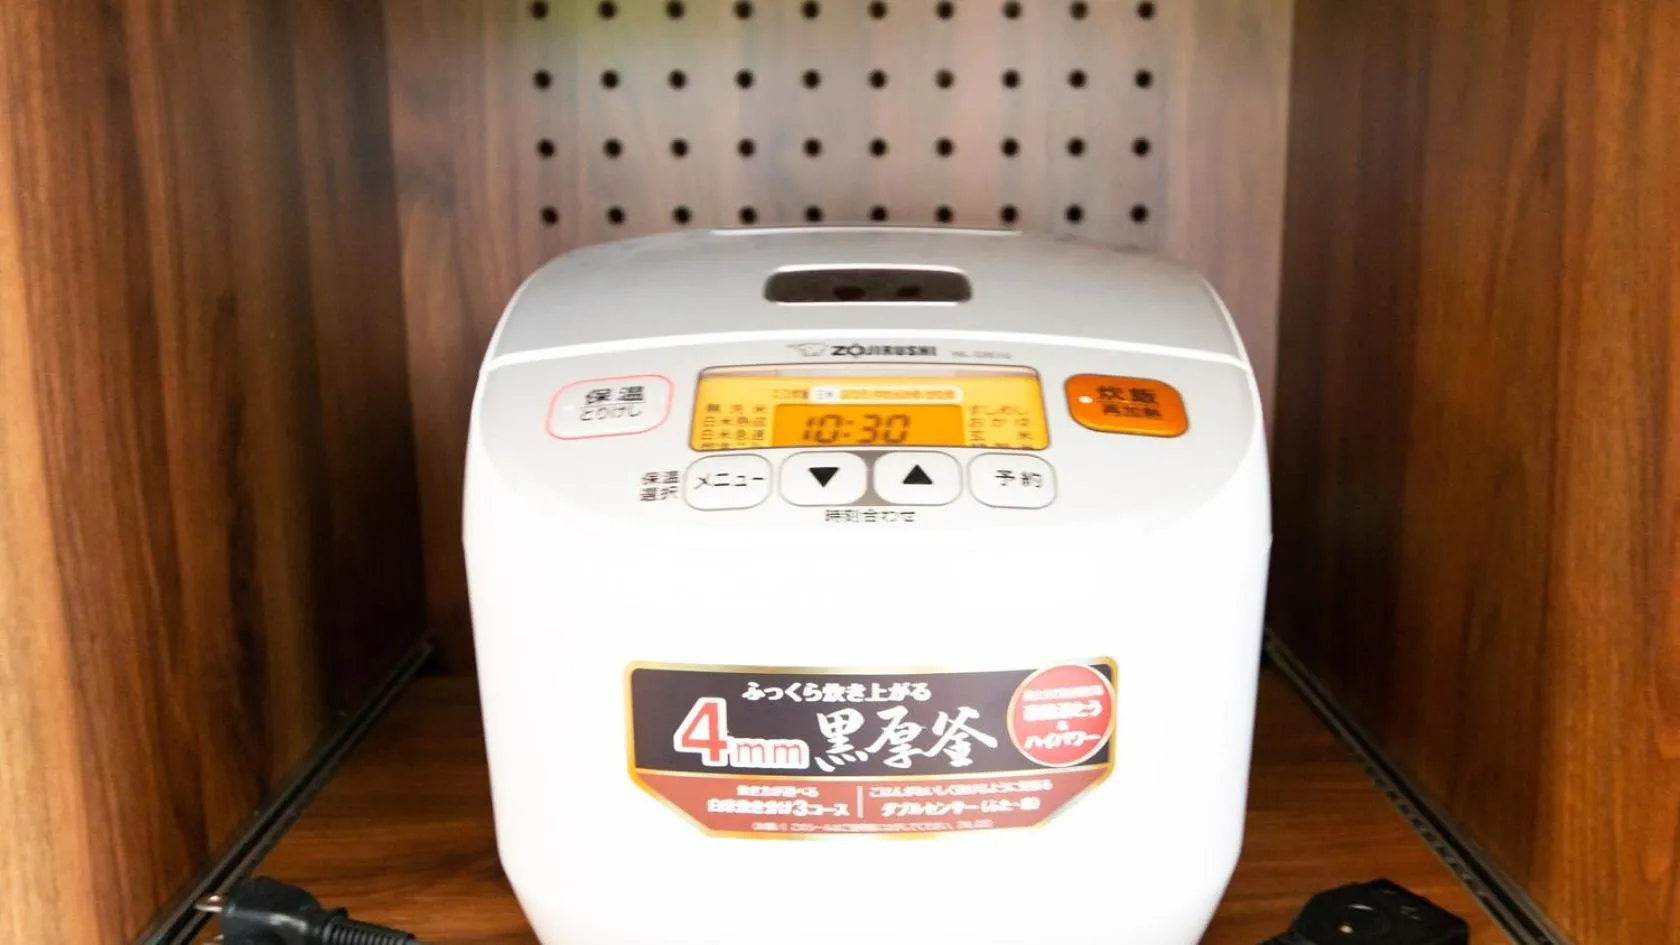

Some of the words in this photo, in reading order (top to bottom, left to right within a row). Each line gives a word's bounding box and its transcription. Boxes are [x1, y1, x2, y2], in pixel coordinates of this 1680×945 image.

[831, 344, 937, 358] ZOJIRUSHI
[585, 386, 644, 405] 保温
[1096, 385, 1157, 403] 炊飯
[580, 404, 643, 421] とりけし
[802, 414, 911, 444] 10:30
[641, 470, 679, 485] 保温
[695, 473, 765, 488] メニュー
[996, 469, 1042, 487] 予約
[640, 486, 678, 501] 選択
[825, 509, 916, 523] 時刻合わせ
[742, 682, 932, 702] ふっくら炊き上がる
[814, 705, 999, 772] 黒厚釜
[1024, 731, 1101, 750] ハイパワー
